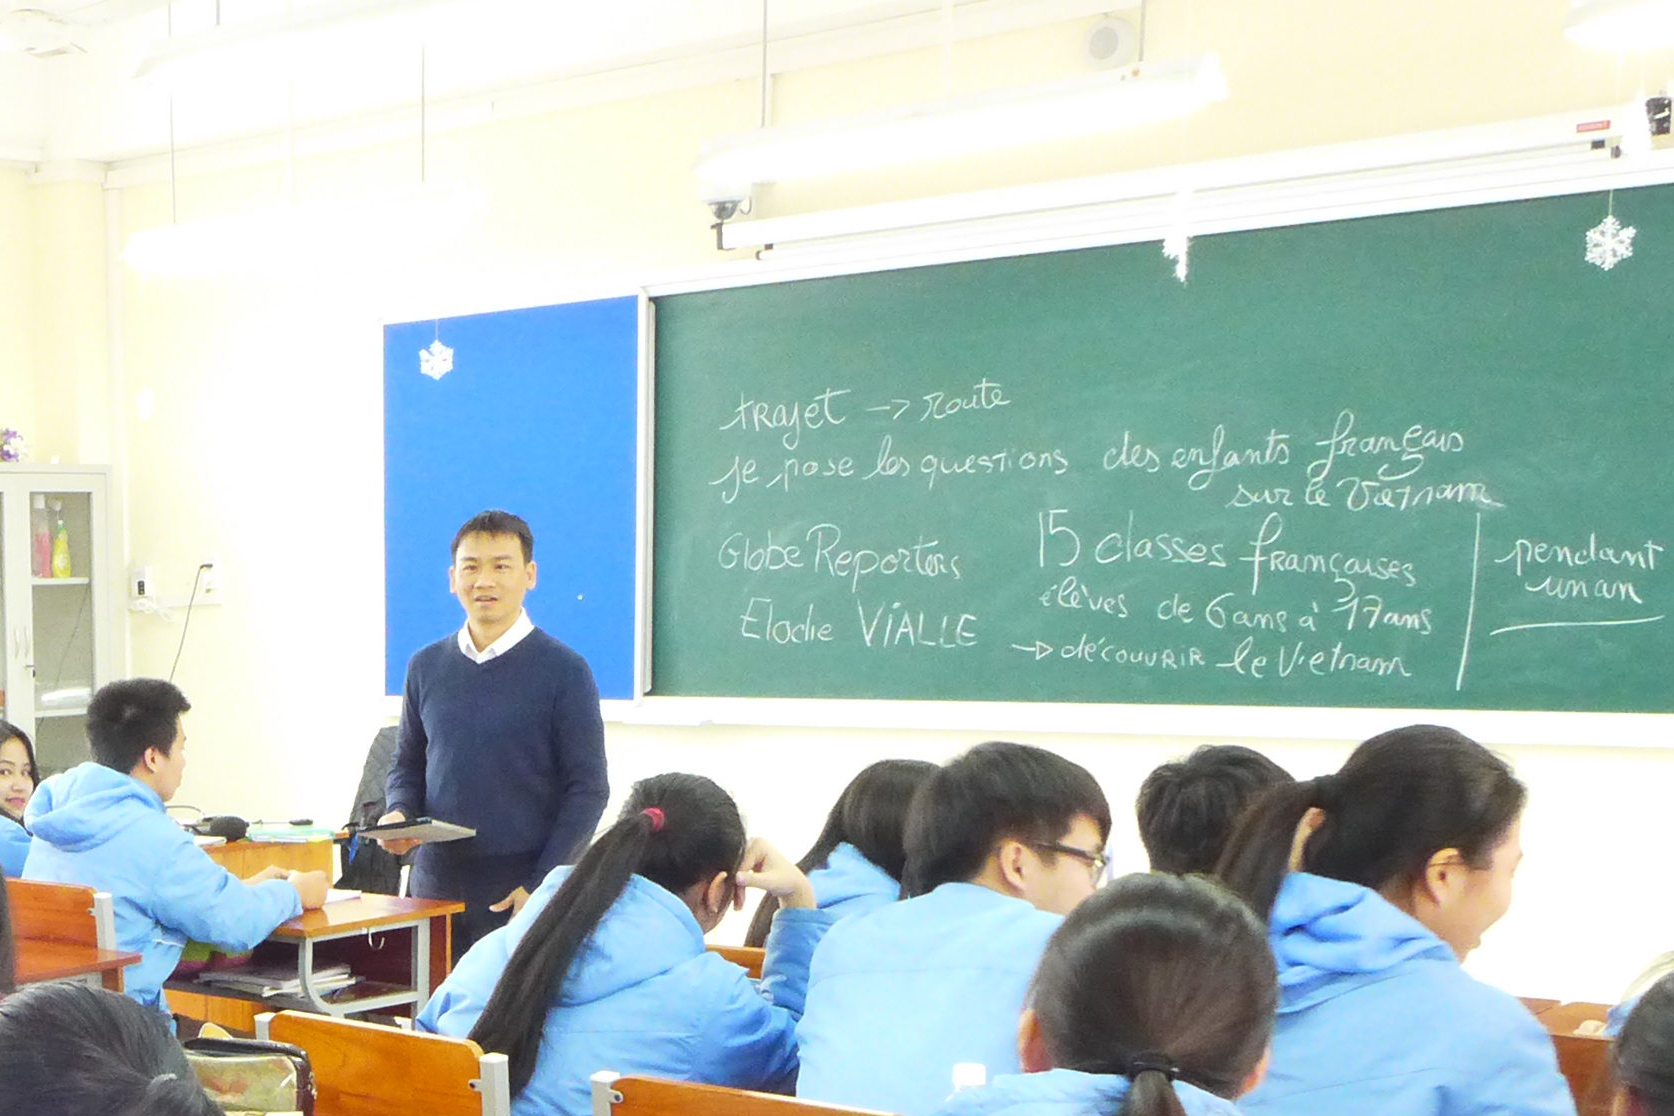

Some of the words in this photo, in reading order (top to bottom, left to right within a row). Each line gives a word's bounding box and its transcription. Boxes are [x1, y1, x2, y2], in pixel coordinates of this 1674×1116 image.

[918, 377, 1011, 423] route
[708, 455, 759, 503] je
[765, 455, 854, 492] pose
[862, 434, 910, 480] les
[919, 448, 1068, 490] questions
[1103, 430, 1160, 472] des
[1170, 424, 1290, 490] enfants
[1306, 408, 1464, 481] français
[1225, 482, 1293, 508] sur
[1304, 477, 1331, 507] le
[1336, 476, 1507, 511] Vietnam
[718, 529, 804, 572] Globe
[1038, 509, 1081, 568] 15
[1095, 509, 1227, 568] classes
[1239, 511, 1416, 602] françaises
[1494, 531, 1664, 576] pendant
[740, 597, 835, 644] Elodie
[1039, 576, 1129, 618] élèves
[1157, 593, 1195, 624] de
[1205, 592, 1234, 629] 6
[1232, 607, 1288, 633] ans
[1298, 601, 1318, 632] à
[1331, 595, 1383, 631] 17
[1382, 607, 1433, 635] ans
[1216, 636, 1268, 678] le
[1278, 641, 1413, 678] Vietnam
